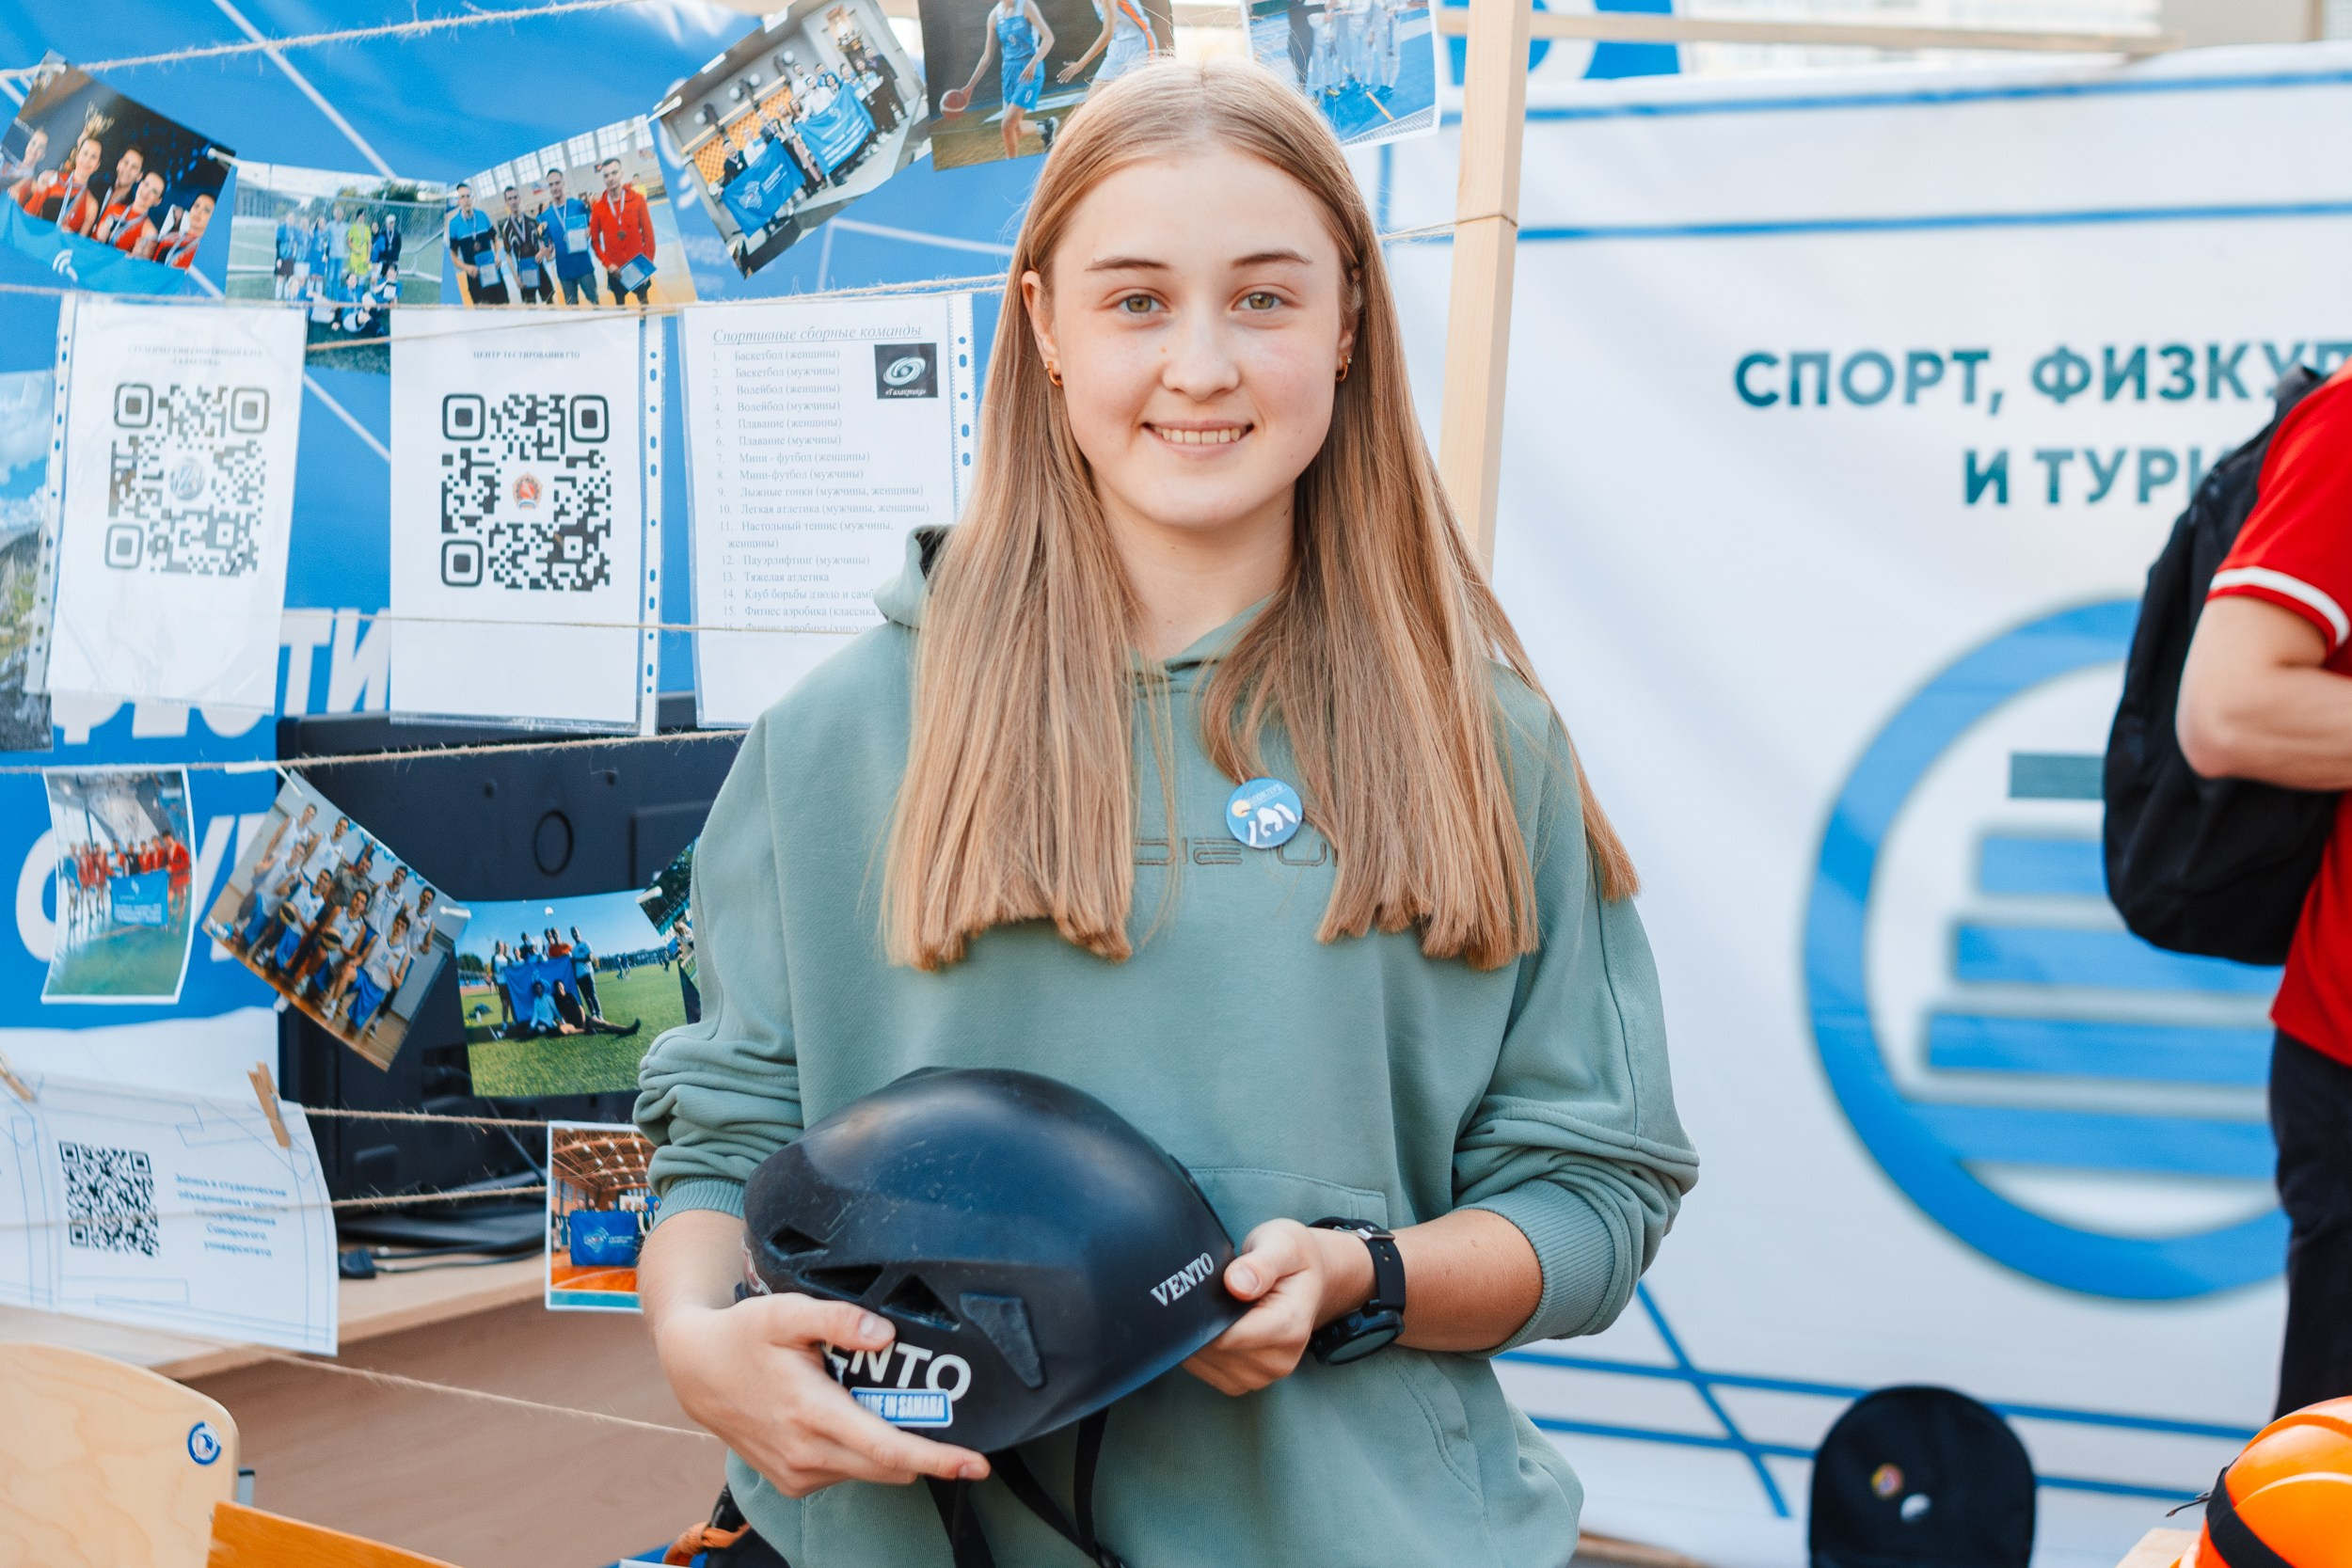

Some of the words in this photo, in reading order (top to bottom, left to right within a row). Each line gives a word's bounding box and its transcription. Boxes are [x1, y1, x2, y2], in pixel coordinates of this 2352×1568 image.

[713, 328, 797, 345] Спортивные
[800, 326, 856, 341] сборные
[860, 325, 922, 339] команды
[735, 349, 783, 361] Баскетбол
[786, 349, 840, 361] (женщины)
[736, 367, 785, 378] Баскетбол
[787, 367, 840, 380] (мужчины)
[1734, 348, 2005, 416] СПОРТ,
[737, 384, 783, 395] Волейбол
[786, 384, 840, 395] (женщины)
[738, 402, 784, 412] Волейбол
[787, 401, 840, 413] (мужчины)
[739, 419, 784, 430] Плавание
[787, 419, 842, 430] (женщины)
[739, 436, 785, 446] Плавание
[787, 436, 841, 448] (мужчины)
[739, 453, 768, 463] Мини
[777, 451, 812, 465] футбол
[815, 452, 870, 464] (женщины)
[739, 469, 807, 482] Мини-футбол
[810, 469, 864, 482] (мужчины)
[1963, 450, 2010, 505] И
[739, 487, 782, 498] Лыжные
[786, 488, 813, 497] гонки
[816, 486, 870, 499] (мужчины,
[871, 485, 924, 497] женщины)
[740, 504, 774, 515] Легкая
[777, 505, 819, 514] атлетика
[822, 503, 875, 515] (мужчины,
[878, 503, 930, 514] женщины)
[741, 521, 801, 531] Настольный
[803, 522, 837, 531] теннис
[839, 521, 893, 533] (мужчины,
[728, 538, 779, 549] женщины)
[743, 555, 814, 567] Пауэрлифтинг
[816, 555, 870, 567] (мужчины)
[744, 571, 785, 582] Тяжелая
[787, 573, 829, 581] атлетика
[745, 589, 769, 602] Клуб
[771, 588, 807, 601] борьбы
[809, 591, 840, 601] дзюдо
[850, 589, 874, 599] самб
[744, 606, 781, 617] Фитнес
[783, 606, 827, 618] аэробика
[1150, 1252, 1215, 1307] VENTO
[884, 1394, 898, 1418] IN
[898, 1395, 946, 1419] SAMARA
